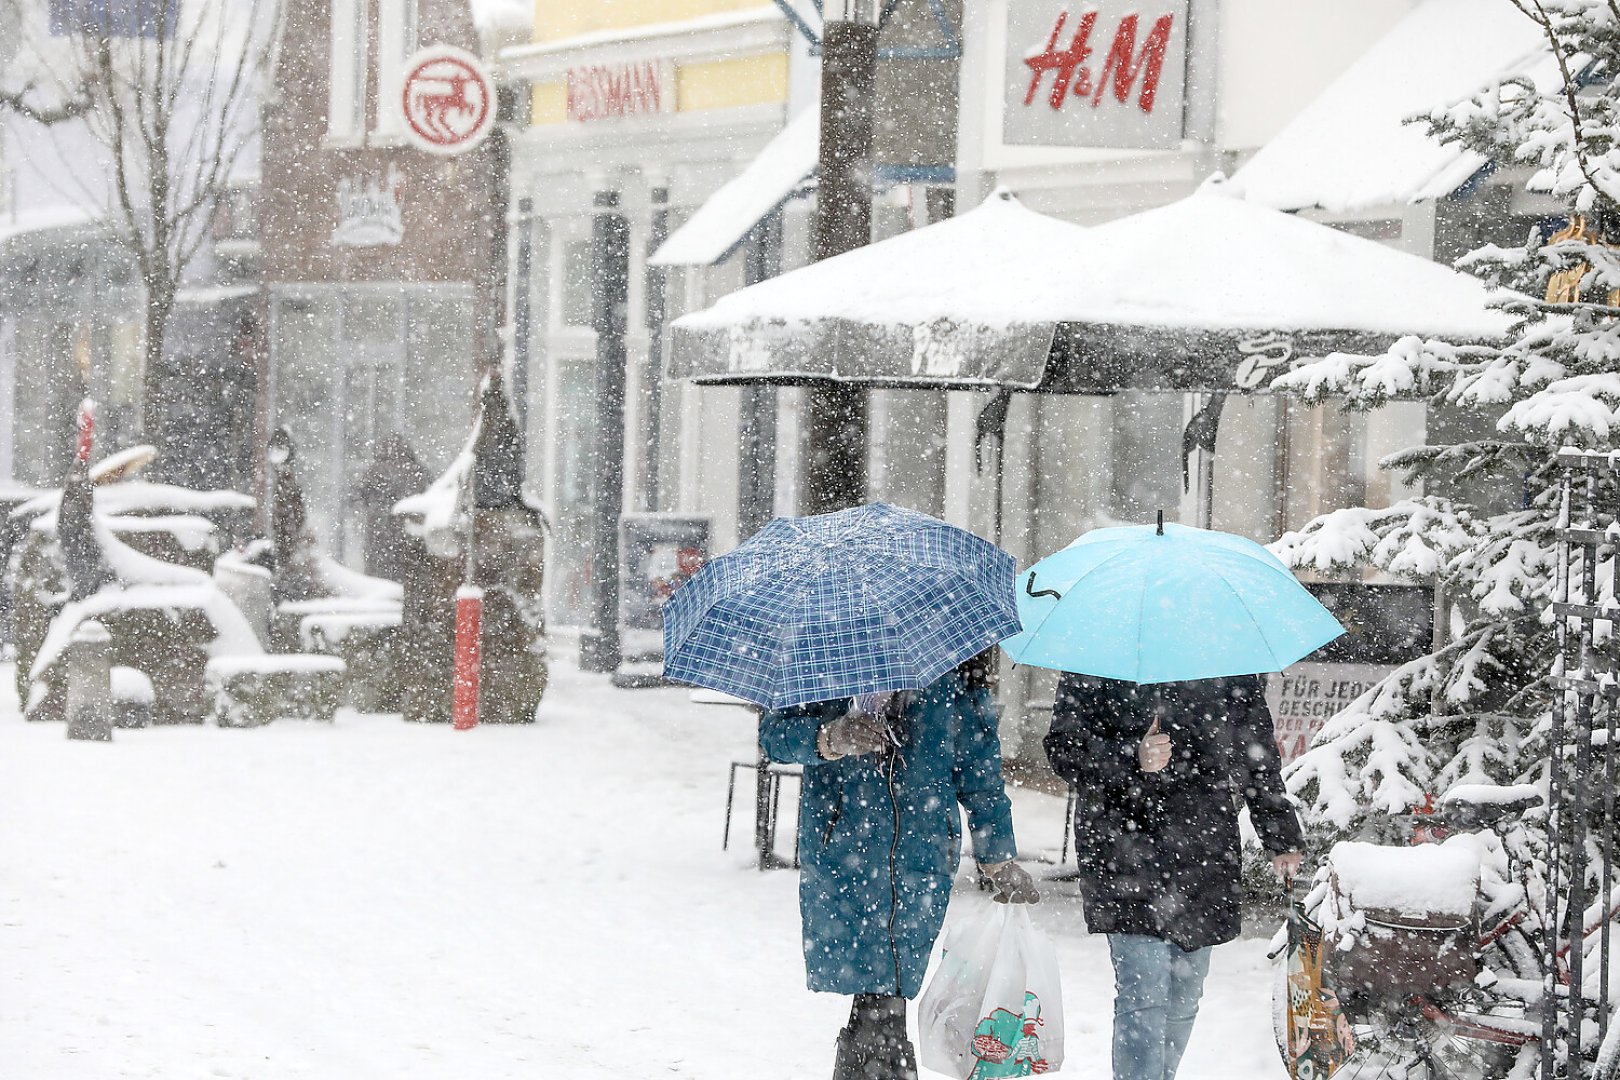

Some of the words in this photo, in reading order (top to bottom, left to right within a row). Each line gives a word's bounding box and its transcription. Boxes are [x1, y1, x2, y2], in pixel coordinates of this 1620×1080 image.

[1024, 11, 1174, 113] H&M
[1281, 675, 1320, 698] FÜR
[1276, 718, 1303, 731] DER
